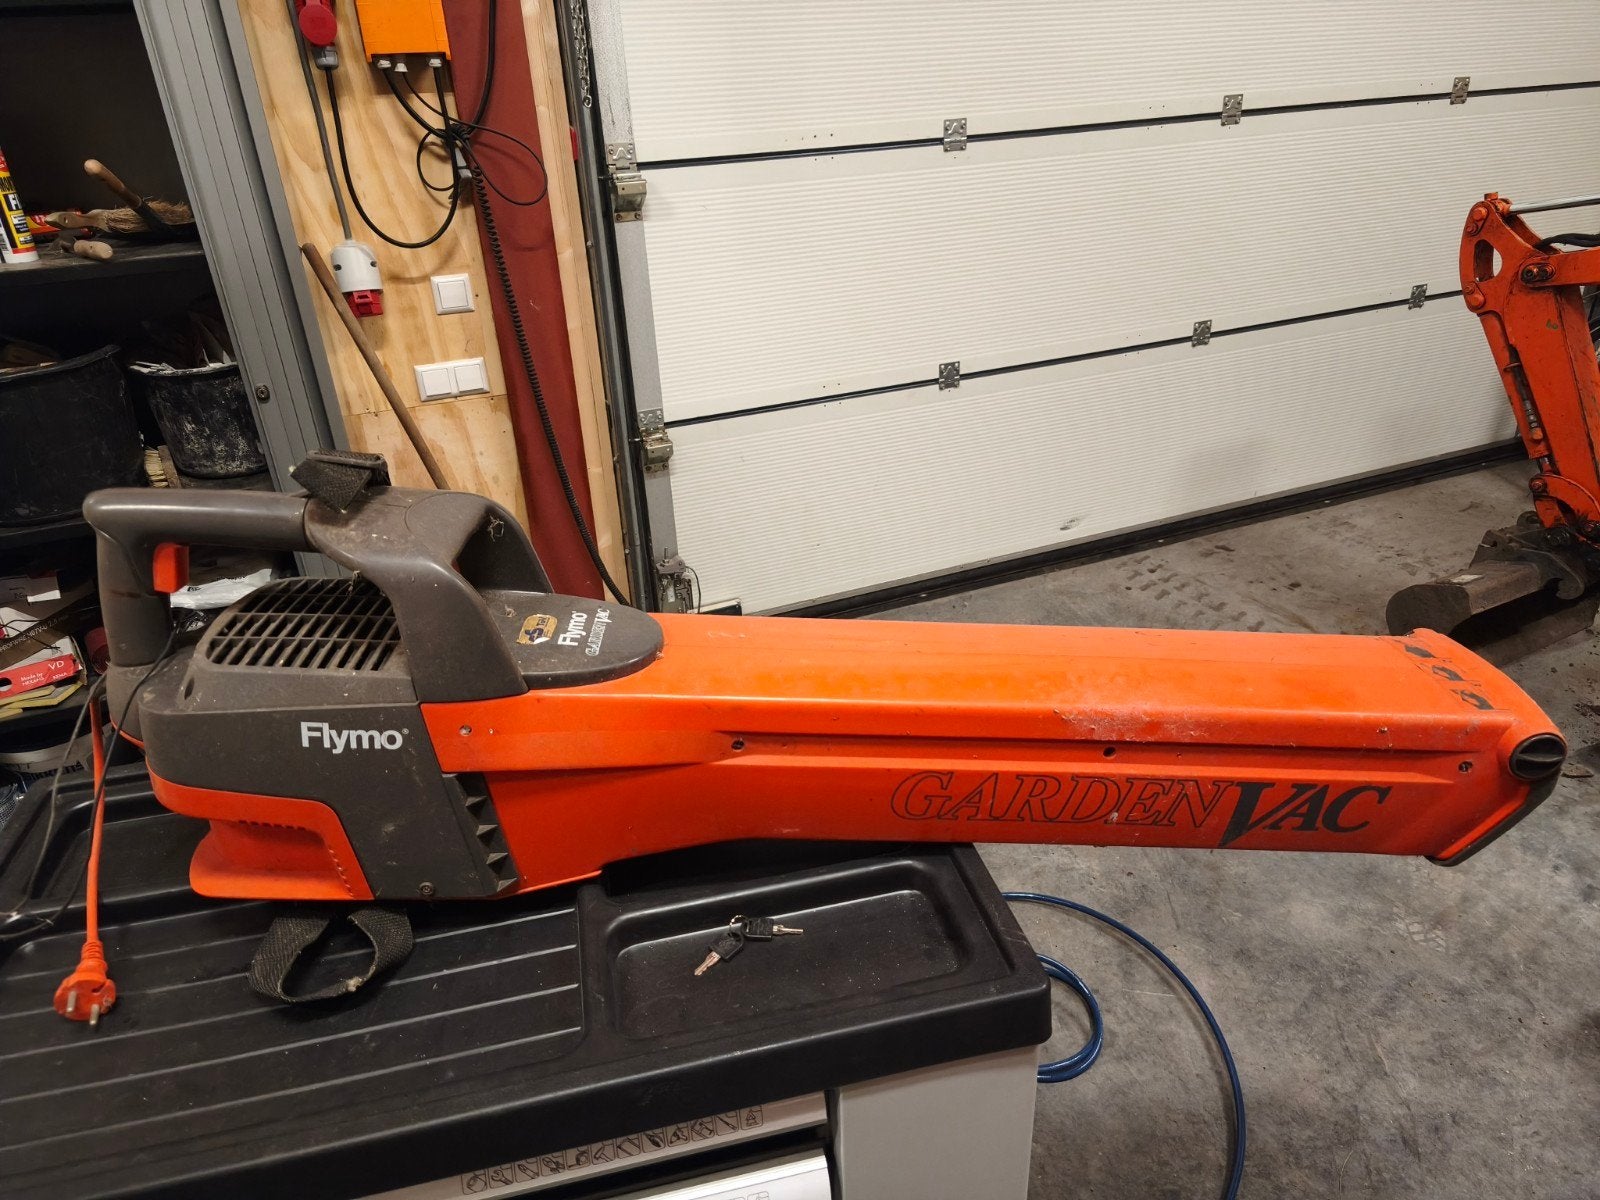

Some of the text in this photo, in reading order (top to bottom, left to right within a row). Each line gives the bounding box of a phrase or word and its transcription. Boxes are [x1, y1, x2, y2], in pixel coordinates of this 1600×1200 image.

[557, 611, 588, 647] Flymo
[48, 660, 65, 670] VD
[300, 721, 404, 755] Flymo
